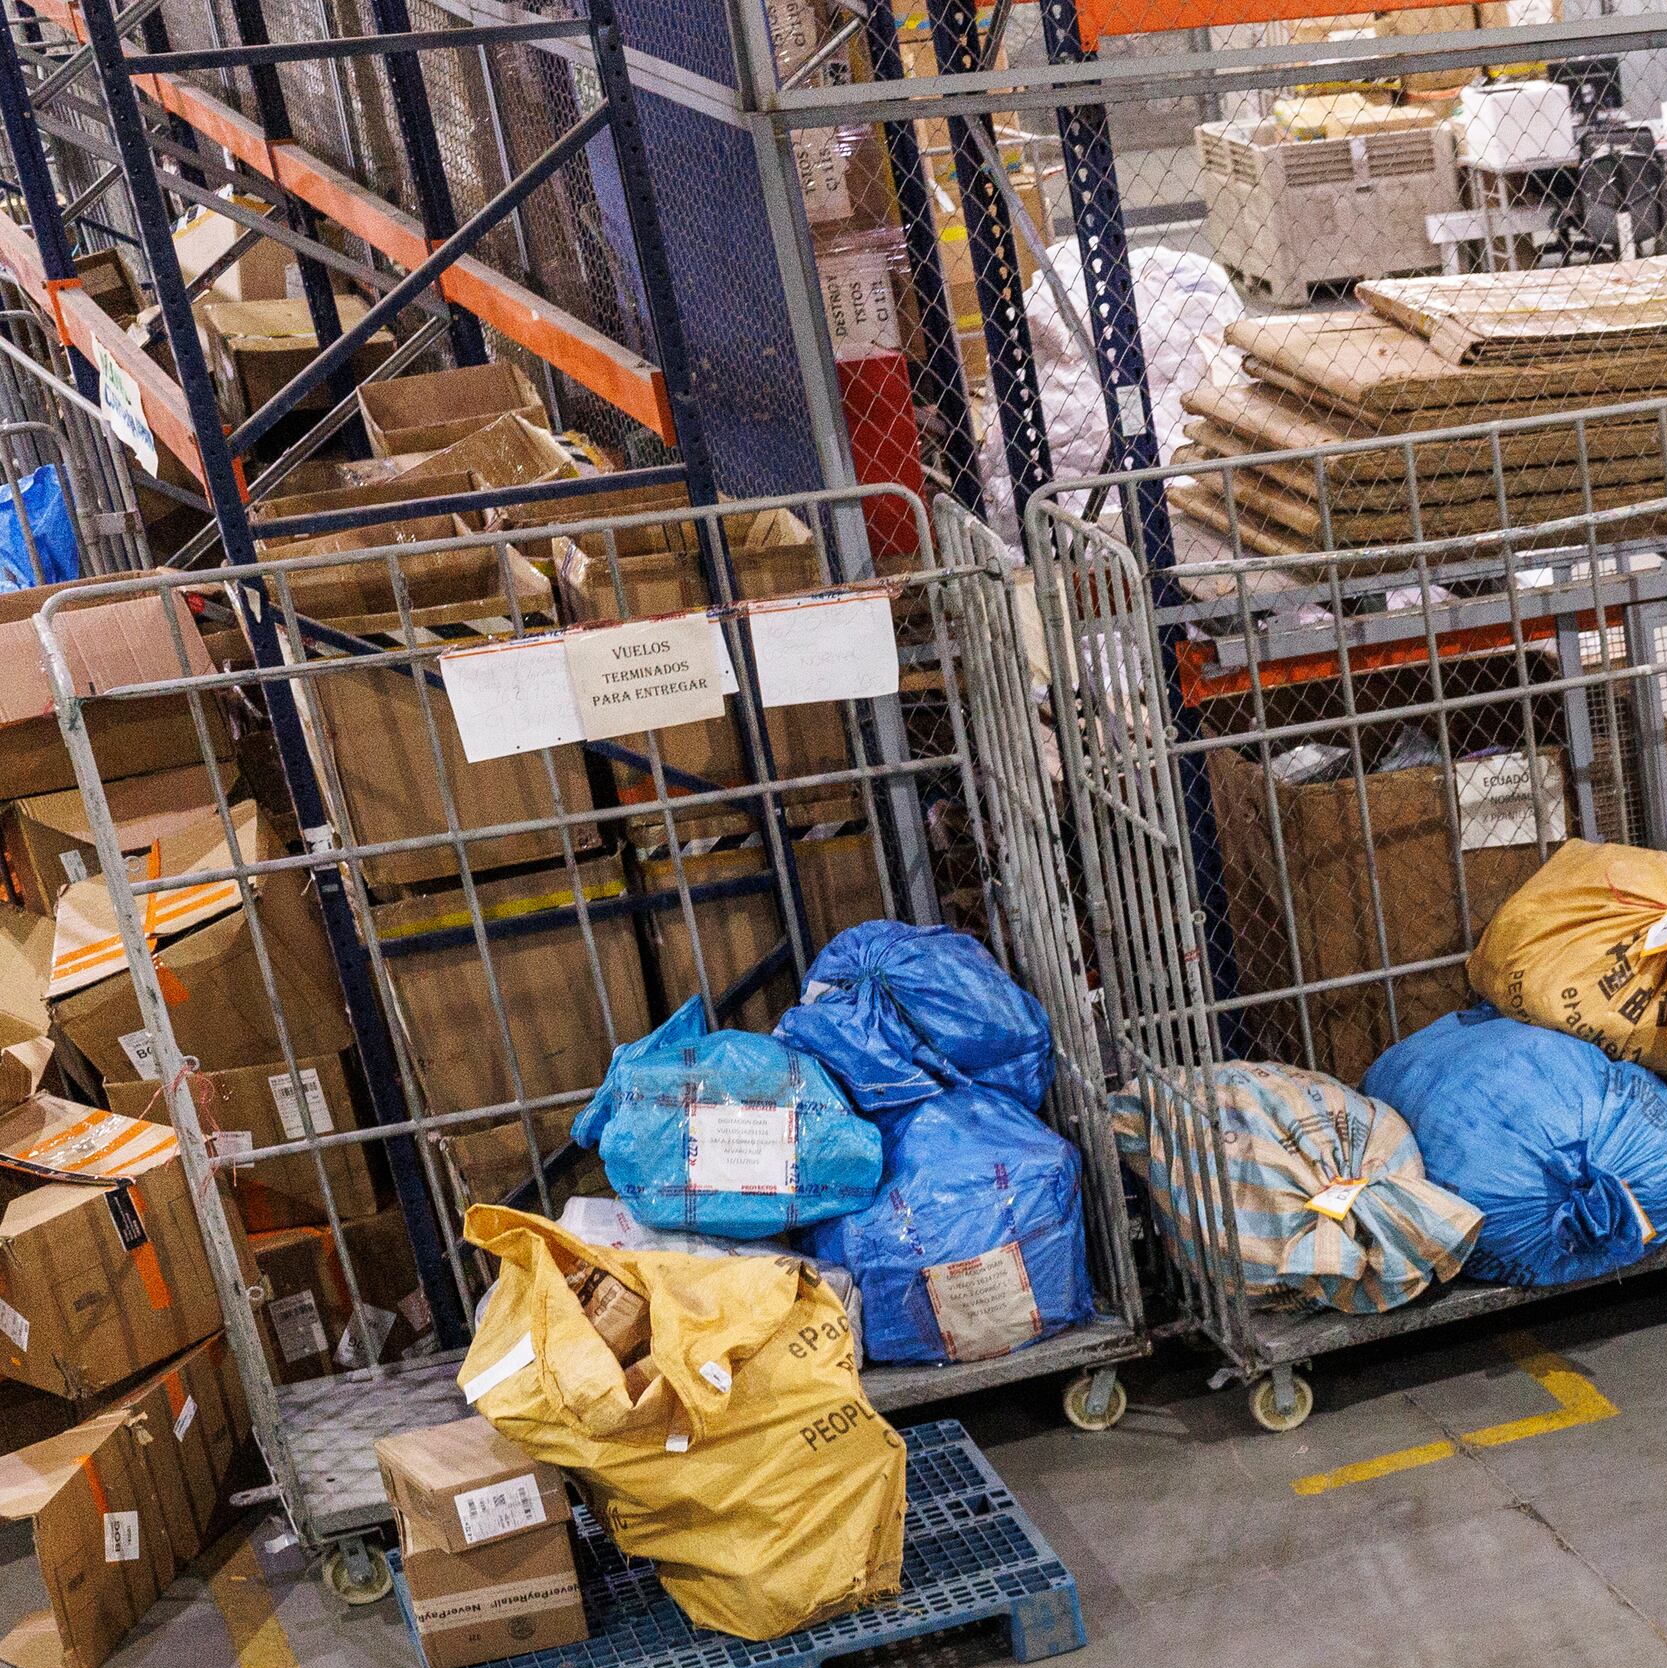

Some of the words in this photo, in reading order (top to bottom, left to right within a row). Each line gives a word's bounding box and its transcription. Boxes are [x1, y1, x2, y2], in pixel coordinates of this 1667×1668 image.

[826, 275, 847, 337] DESTROY
[612, 640, 671, 660] VUELOS
[602, 661, 689, 684] TERMINADOS
[592, 691, 632, 706] PARA
[635, 679, 708, 700] ENTREGAR
[1483, 771, 1530, 787] ECUADO
